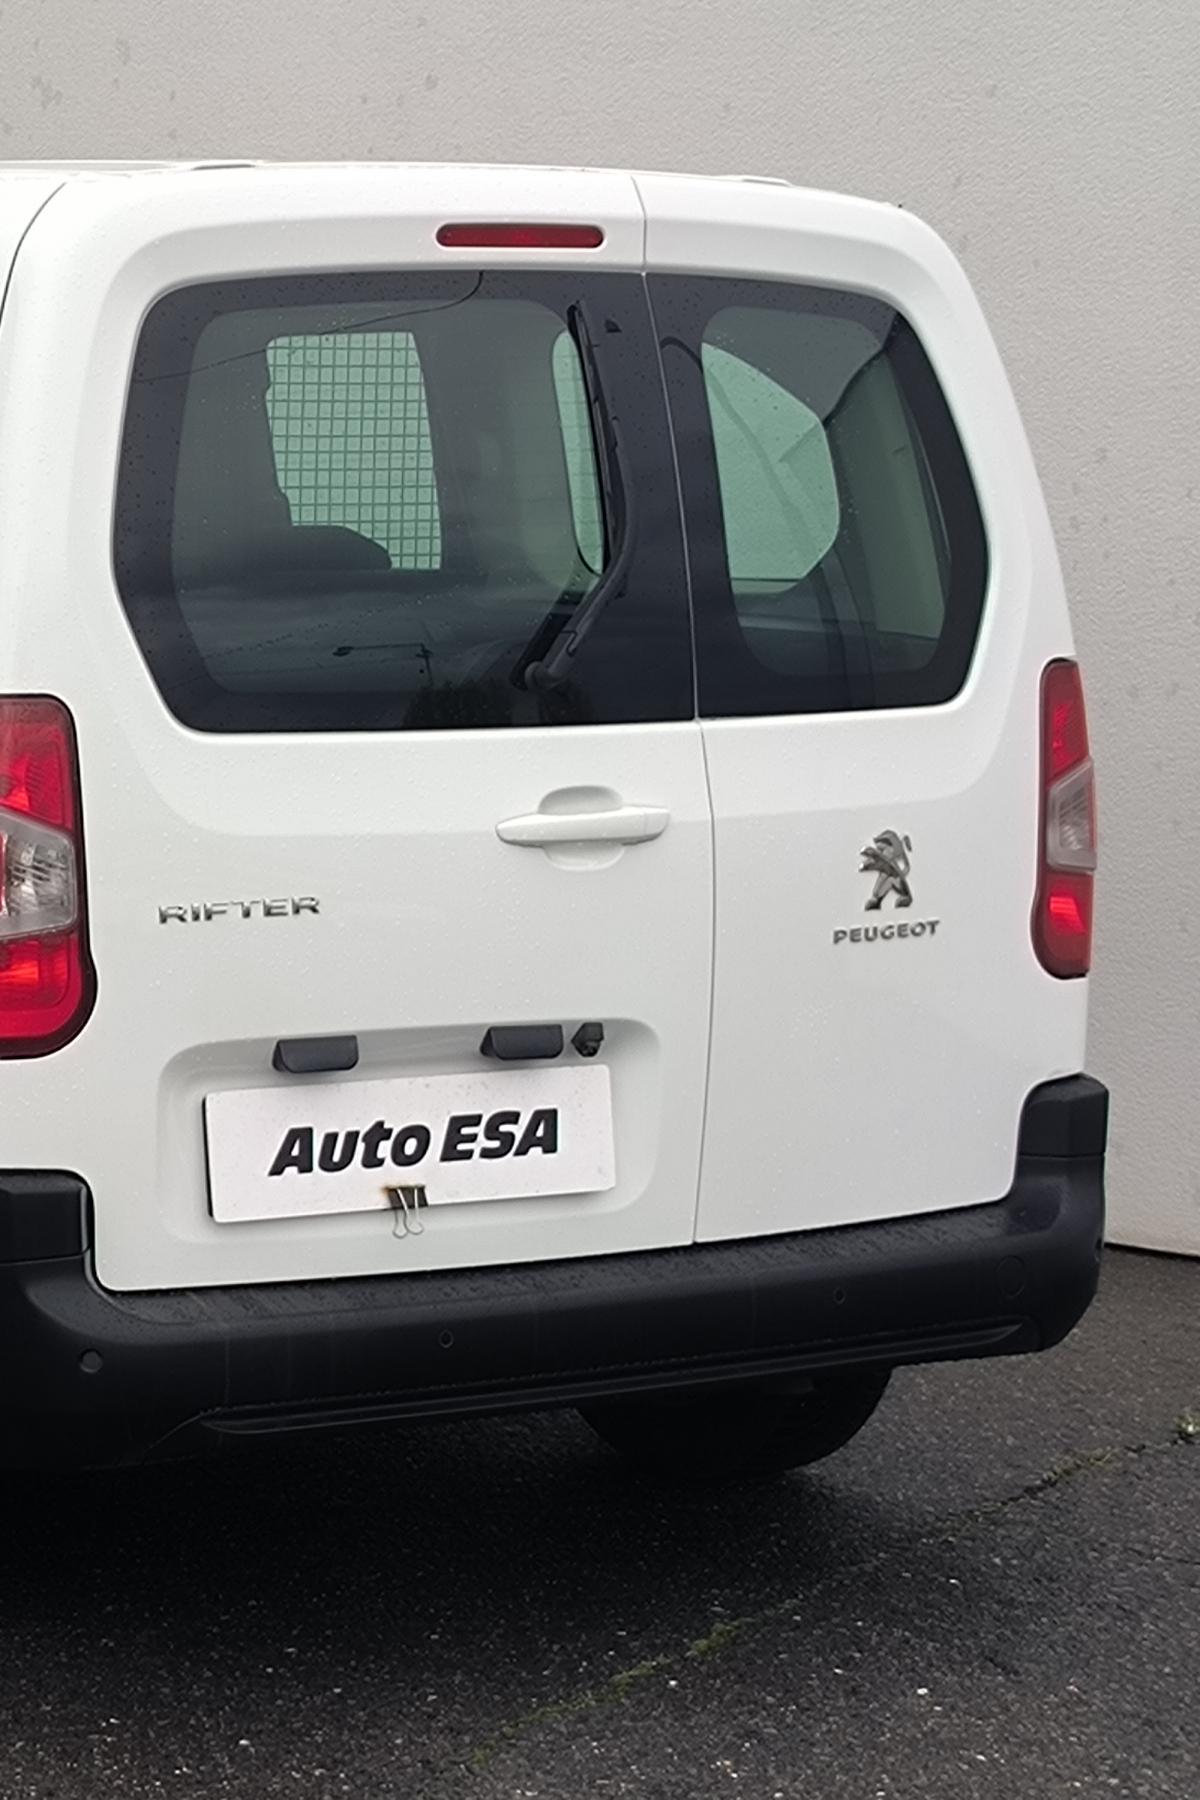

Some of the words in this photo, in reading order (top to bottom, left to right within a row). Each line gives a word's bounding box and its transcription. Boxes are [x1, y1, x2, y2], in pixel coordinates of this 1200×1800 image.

[159, 896, 320, 924] RIFTER
[833, 919, 940, 944] PEUGEOT
[268, 1120, 431, 1177] Auto
[439, 1107, 559, 1163] ESA
